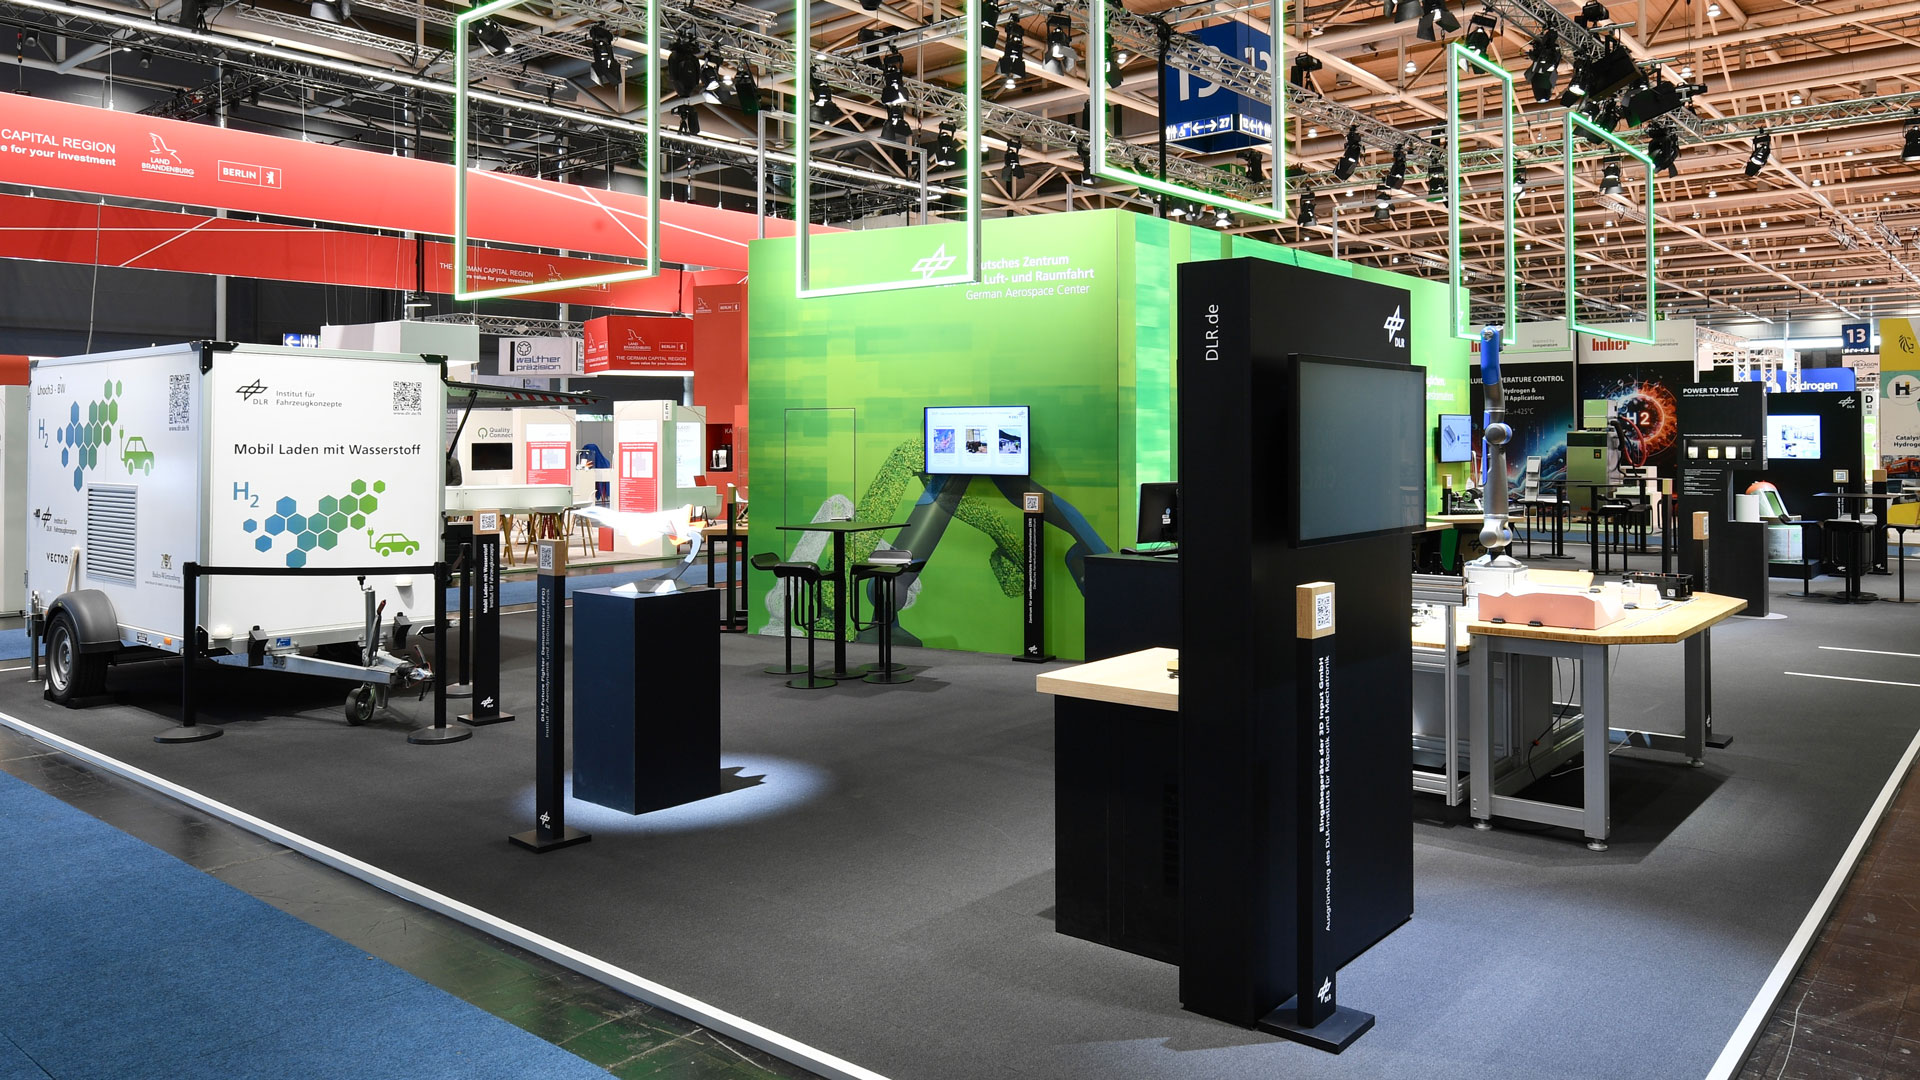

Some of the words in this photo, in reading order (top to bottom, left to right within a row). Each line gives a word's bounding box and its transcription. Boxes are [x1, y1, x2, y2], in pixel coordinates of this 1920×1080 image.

[1219, 117, 1230, 129] 27
[1, 128, 59, 147] CAPITAL
[62, 136, 116, 154] REGION
[10, 144, 27, 155] for
[29, 147, 55, 160] your
[57, 150, 116, 167] investment
[150, 157, 170, 166] LAND
[141, 162, 195, 177] BRANDENBURG
[222, 167, 257, 180] BERLIN
[980, 258, 1020, 270] utsches
[1023, 255, 1069, 268] Zentrum
[439, 262, 453, 270] THE
[483, 268, 509, 276] CAPITAL
[509, 270, 534, 278] REGION
[983, 272, 1008, 285] Luft-
[1011, 272, 1033, 283] und
[1035, 268, 1095, 282] Raumfahrt
[966, 289, 1003, 301] German
[1005, 286, 1054, 299] Aerospace
[1056, 284, 1090, 296] Center
[1204, 304, 1218, 361] DLR.de
[1846, 328, 1866, 344] 13
[1394, 337, 1405, 348] DLR
[1592, 338, 1630, 351] huber
[1501, 376, 1532, 384] ERATURE
[37, 385, 54, 396] Lhoch3
[57, 384, 66, 394] BW
[276, 390, 303, 398] Institut
[276, 399, 343, 408] Fahrzeugkonzepte
[1865, 395, 1873, 404] D
[234, 443, 274, 455] Mobil
[279, 444, 319, 455] Laden
[323, 444, 344, 455] mit
[349, 444, 421, 455] Wasserstoff
[46, 552, 69, 564] VECTOR
[1319, 722, 1324, 736] 3D
[1318, 758, 1326, 833] Eingabegeräte
